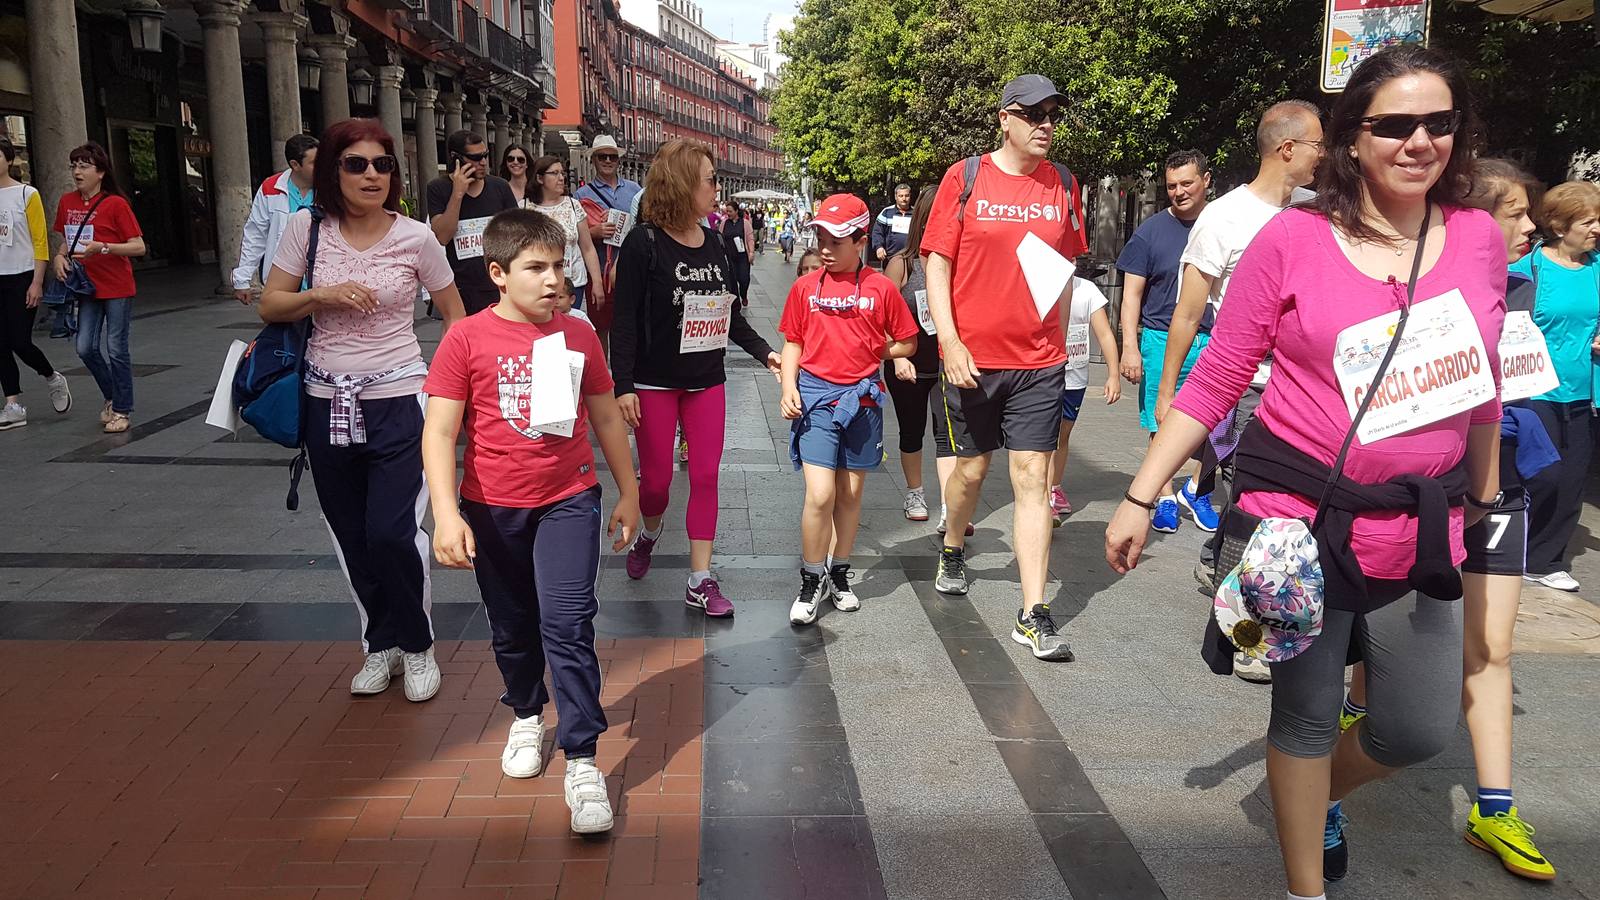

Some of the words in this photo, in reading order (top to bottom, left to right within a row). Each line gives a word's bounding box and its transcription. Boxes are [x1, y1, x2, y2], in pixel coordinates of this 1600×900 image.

[456, 236, 470, 250] THE
[675, 262, 724, 281] Can't
[683, 318, 728, 338] PERSYSOL
[1413, 345, 1481, 394] GARRIDO
[1502, 351, 1545, 379] GARRIDO
[1486, 514, 1511, 550] 7
